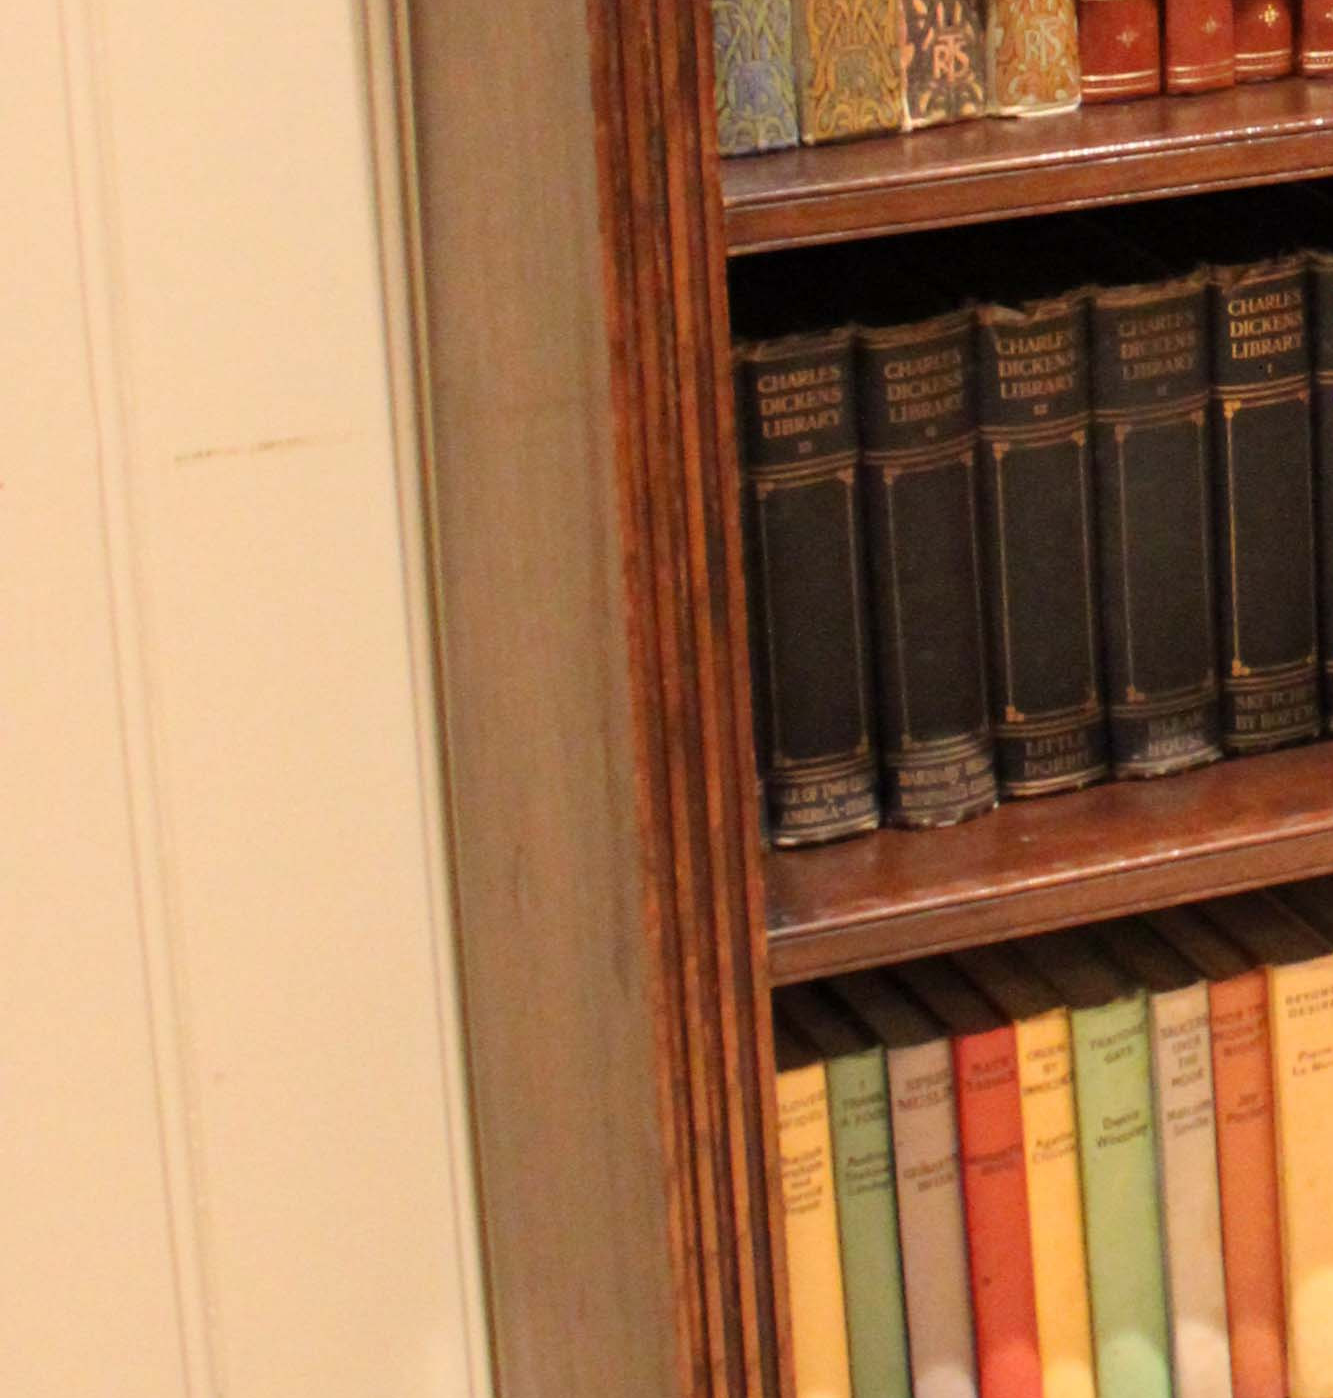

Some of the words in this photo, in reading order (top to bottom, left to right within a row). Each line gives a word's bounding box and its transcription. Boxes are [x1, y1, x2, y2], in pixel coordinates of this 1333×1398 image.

[1227, 289, 1302, 317] CHARLES
[1119, 311, 1195, 338] CHARLES
[1229, 311, 1304, 338] DICKENS
[995, 330, 1075, 357] CHARLES
[1120, 332, 1197, 359] DICKENS
[1232, 332, 1303, 360] LIBRARY
[884, 350, 962, 381] CHARLES
[998, 351, 1076, 379] DICKENS
[1122, 354, 1196, 381] LIBRARY
[757, 365, 842, 394] CHARLES
[887, 371, 964, 402] DICKENS
[1000, 372, 1077, 401] LIBRARY
[760, 388, 843, 417] DICKENS
[889, 393, 964, 424] LIBRARY
[762, 409, 841, 439] LIBRARY
[1103, 1045, 1135, 1065] GATE
